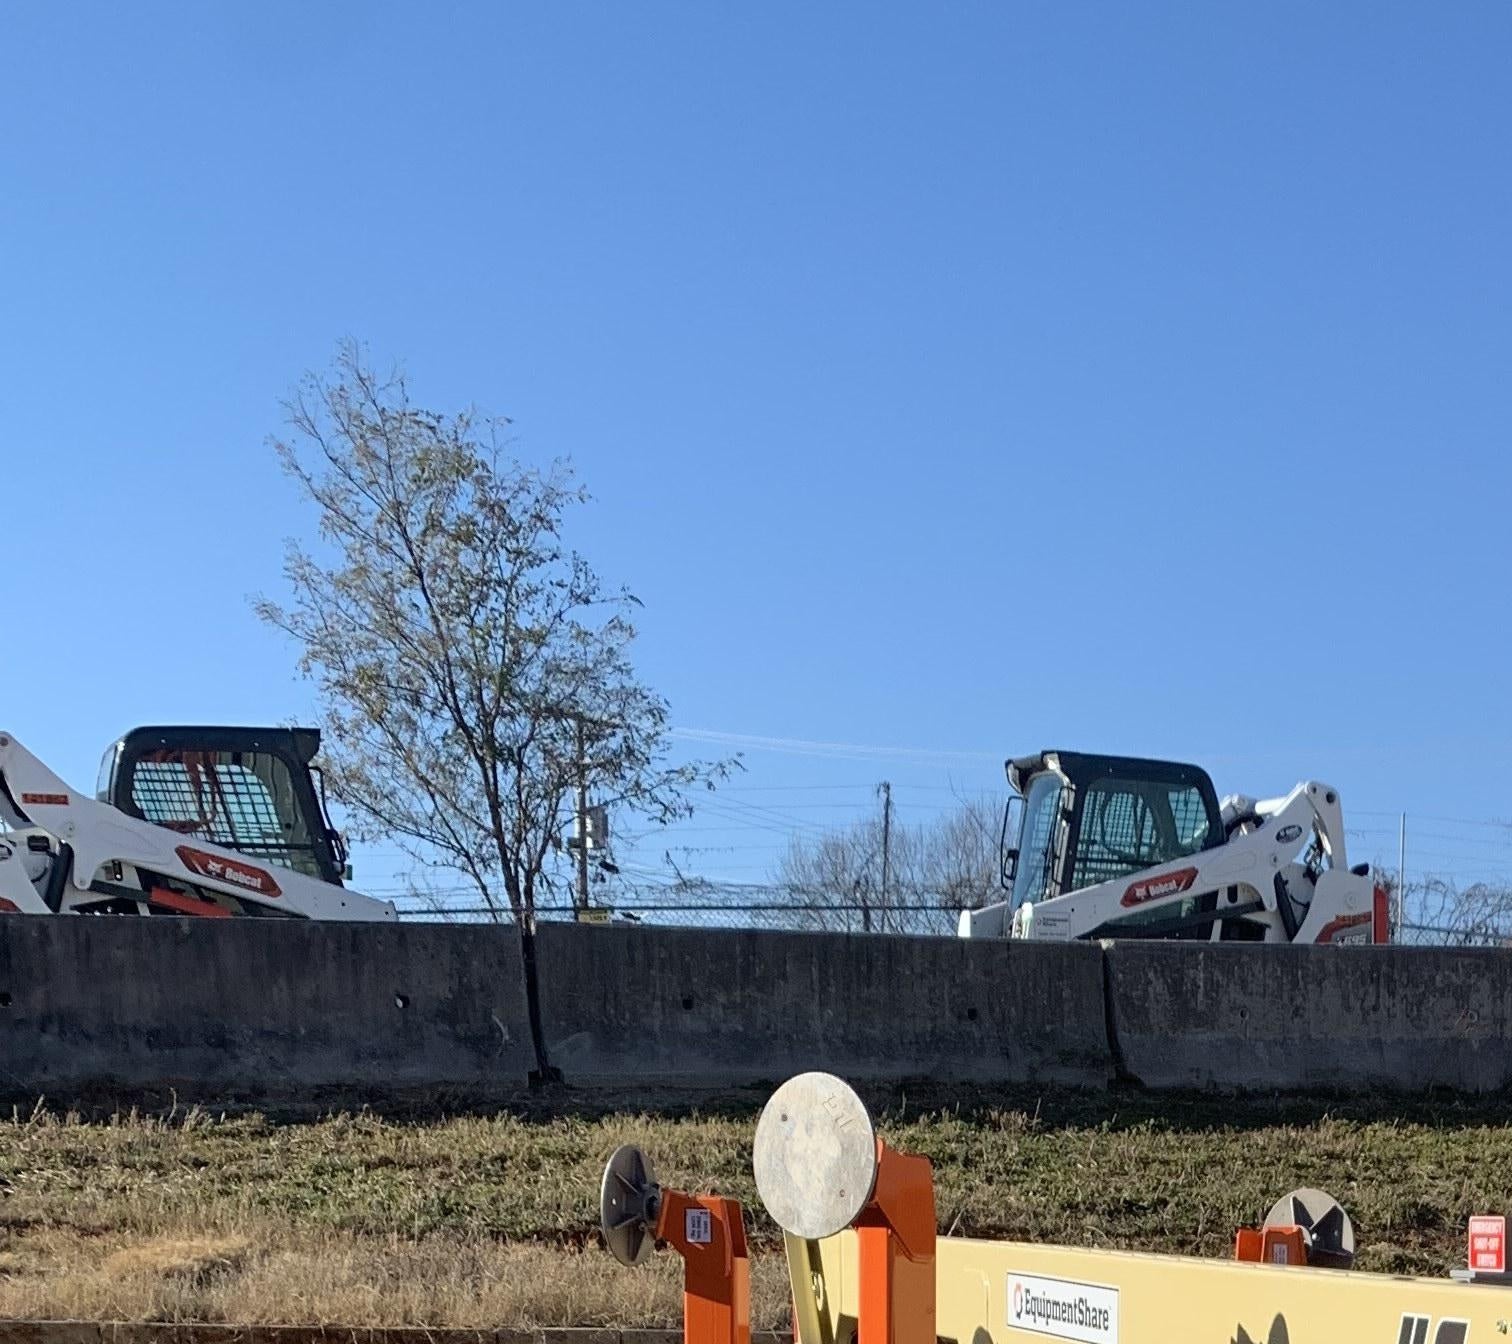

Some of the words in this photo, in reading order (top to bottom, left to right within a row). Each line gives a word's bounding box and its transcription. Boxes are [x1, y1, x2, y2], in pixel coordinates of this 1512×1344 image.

[225, 868, 262, 888] Bobcat
[1148, 880, 1177, 897] Bobcat
[1024, 1287, 1109, 1331] EquipmentShare
